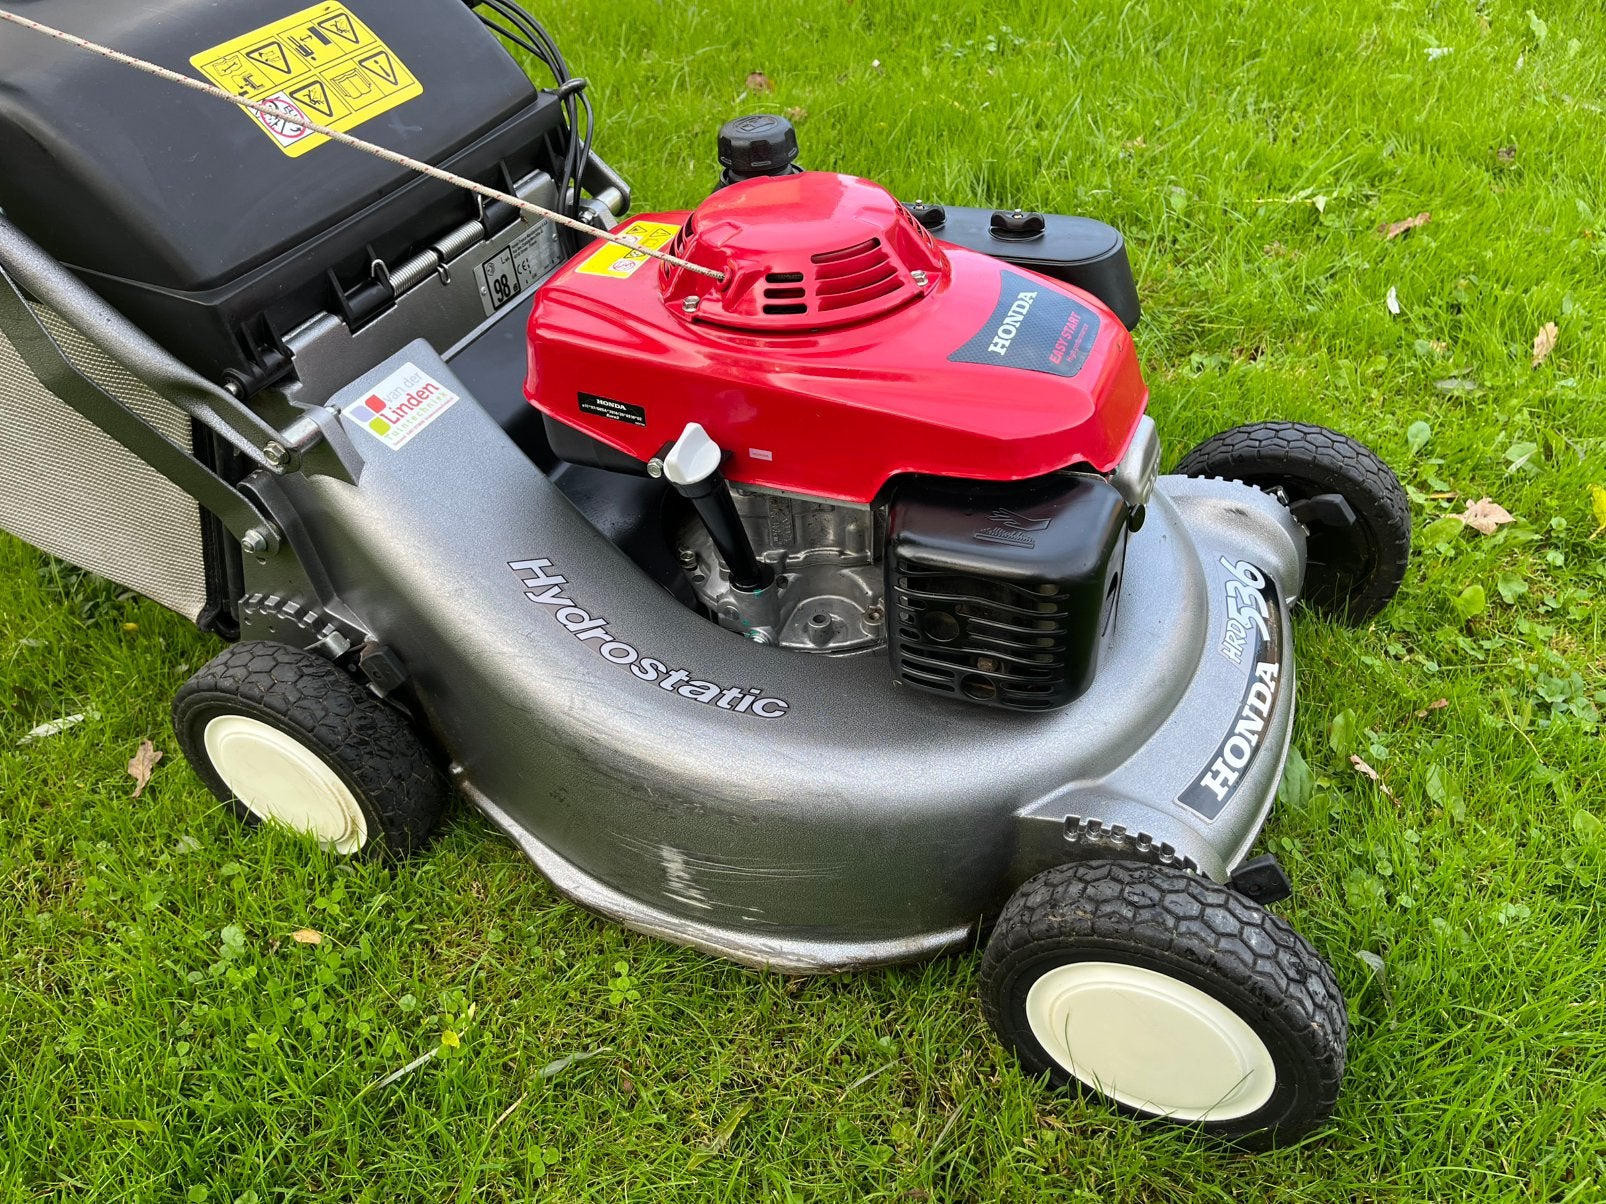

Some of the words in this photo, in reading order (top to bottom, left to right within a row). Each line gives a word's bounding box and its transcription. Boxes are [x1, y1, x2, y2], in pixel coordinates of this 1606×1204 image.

[493, 274, 511, 303] 98
[987, 291, 1038, 356] HONDA
[1049, 336, 1067, 365] EASY
[1062, 311, 1081, 340] START
[380, 382, 440, 425] Linden
[383, 387, 406, 403] van
[404, 372, 422, 388] der
[596, 399, 627, 411] HONDA
[507, 558, 790, 718] Hydrostatic
[1200, 661, 1280, 802] HONDA
